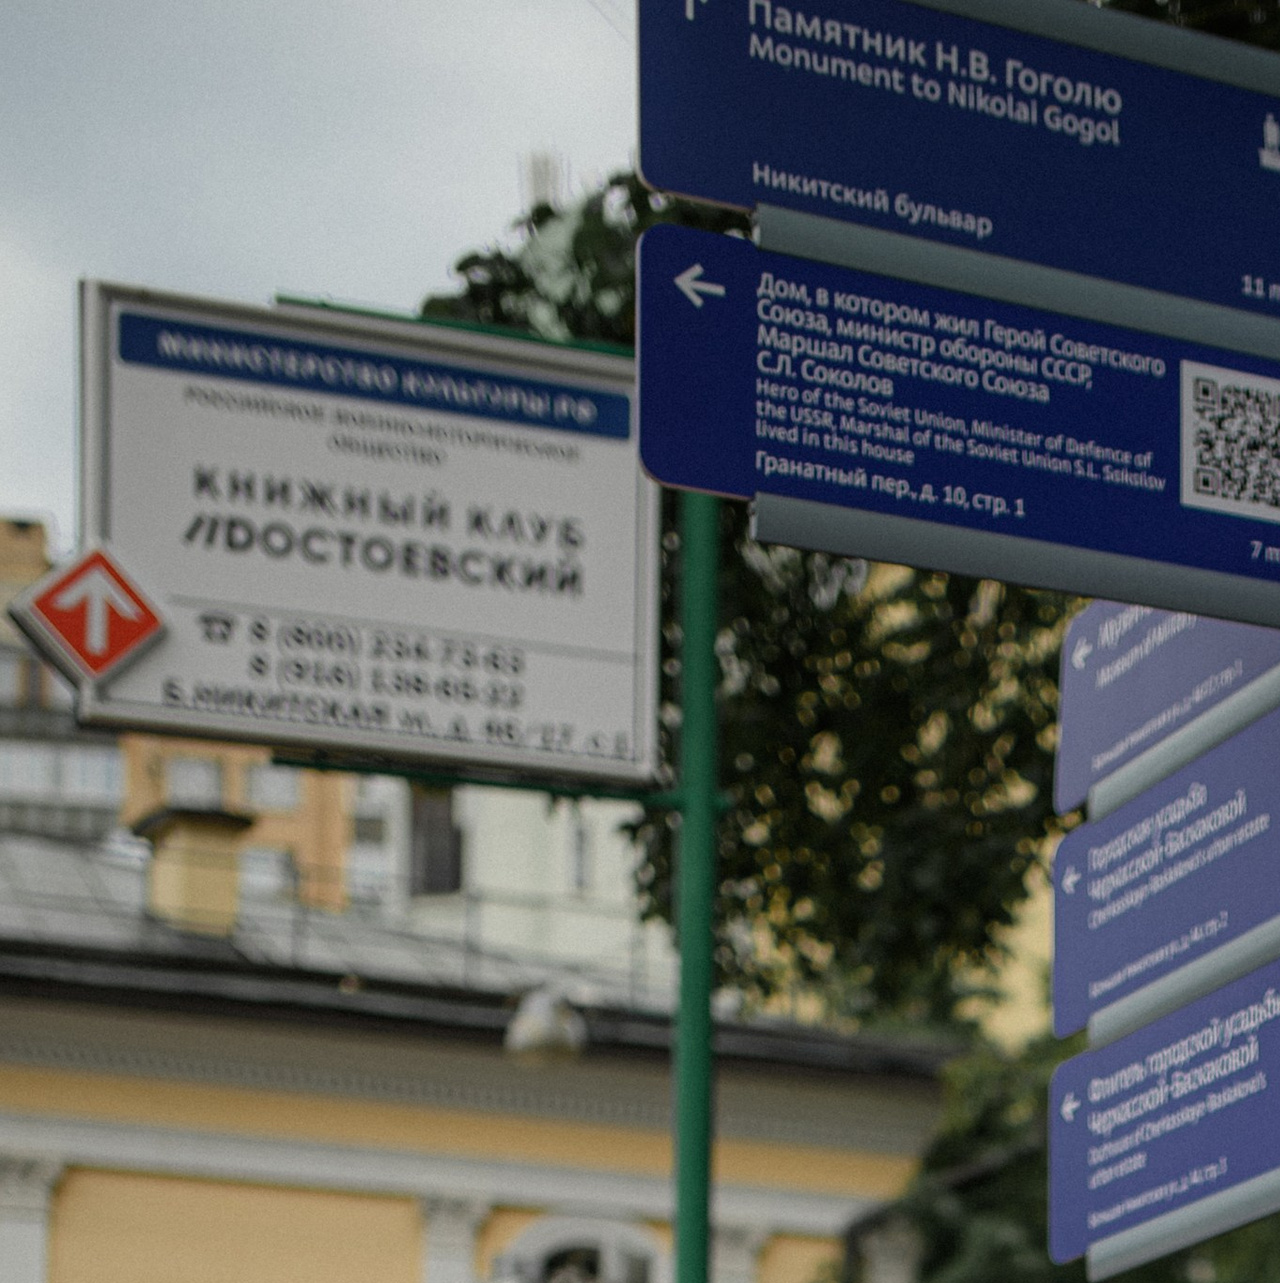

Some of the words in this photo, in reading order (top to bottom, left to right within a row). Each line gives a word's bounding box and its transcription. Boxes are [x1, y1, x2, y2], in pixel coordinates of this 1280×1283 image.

[748, 0, 927, 66] Памятник
[935, 42, 997, 83] Н.В.
[1005, 59, 1123, 115] Гоголю
[748, 33, 906, 93] Monument
[911, 73, 941, 101] to
[948, 81, 1038, 124] Nikolai
[1044, 106, 1121, 145] Gogol
[752, 162, 890, 212] Никитский
[894, 193, 994, 238] бульвар
[1242, 275, 1265, 297] 11
[756, 295, 832, 337] Союза,
[836, 315, 934, 358] министр
[939, 336, 1037, 377] обороны
[1041, 356, 1093, 390] СССР,
[756, 324, 853, 365] Маршал
[857, 344, 978, 390] Советского
[981, 366, 1050, 404] Союза
[757, 272, 811, 307] Дом,
[816, 285, 828, 309] в
[834, 289, 930, 331] котором
[934, 310, 979, 343] жил
[984, 319, 1045, 359] Герой
[1050, 333, 1166, 380] Советского
[756, 350, 796, 378] С.Л.
[800, 358, 893, 397] Соколов
[756, 378, 798, 403] Hero
[801, 387, 821, 410] of
[824, 391, 854, 413] the
[857, 397, 910, 424] Soviet
[971, 419, 1041, 447] Minister
[1045, 433, 1063, 451] of
[1133, 449, 1153, 468] of
[756, 400, 786, 423] the
[840, 415, 909, 445] Marshal
[912, 429, 931, 449] of
[934, 434, 963, 455] the
[966, 439, 1017, 465] Soviet
[1021, 450, 1071, 475] Union
[756, 419, 798, 444] lived
[802, 428, 820, 448] in
[823, 430, 858, 455] this
[861, 439, 914, 465] house
[191, 464, 456, 532] КНИЖНЫЙ
[466, 503, 588, 551] КЛУБ
[755, 450, 866, 493] Гранатный
[1013, 498, 1024, 521] 1
[1249, 540, 1263, 560] 7
